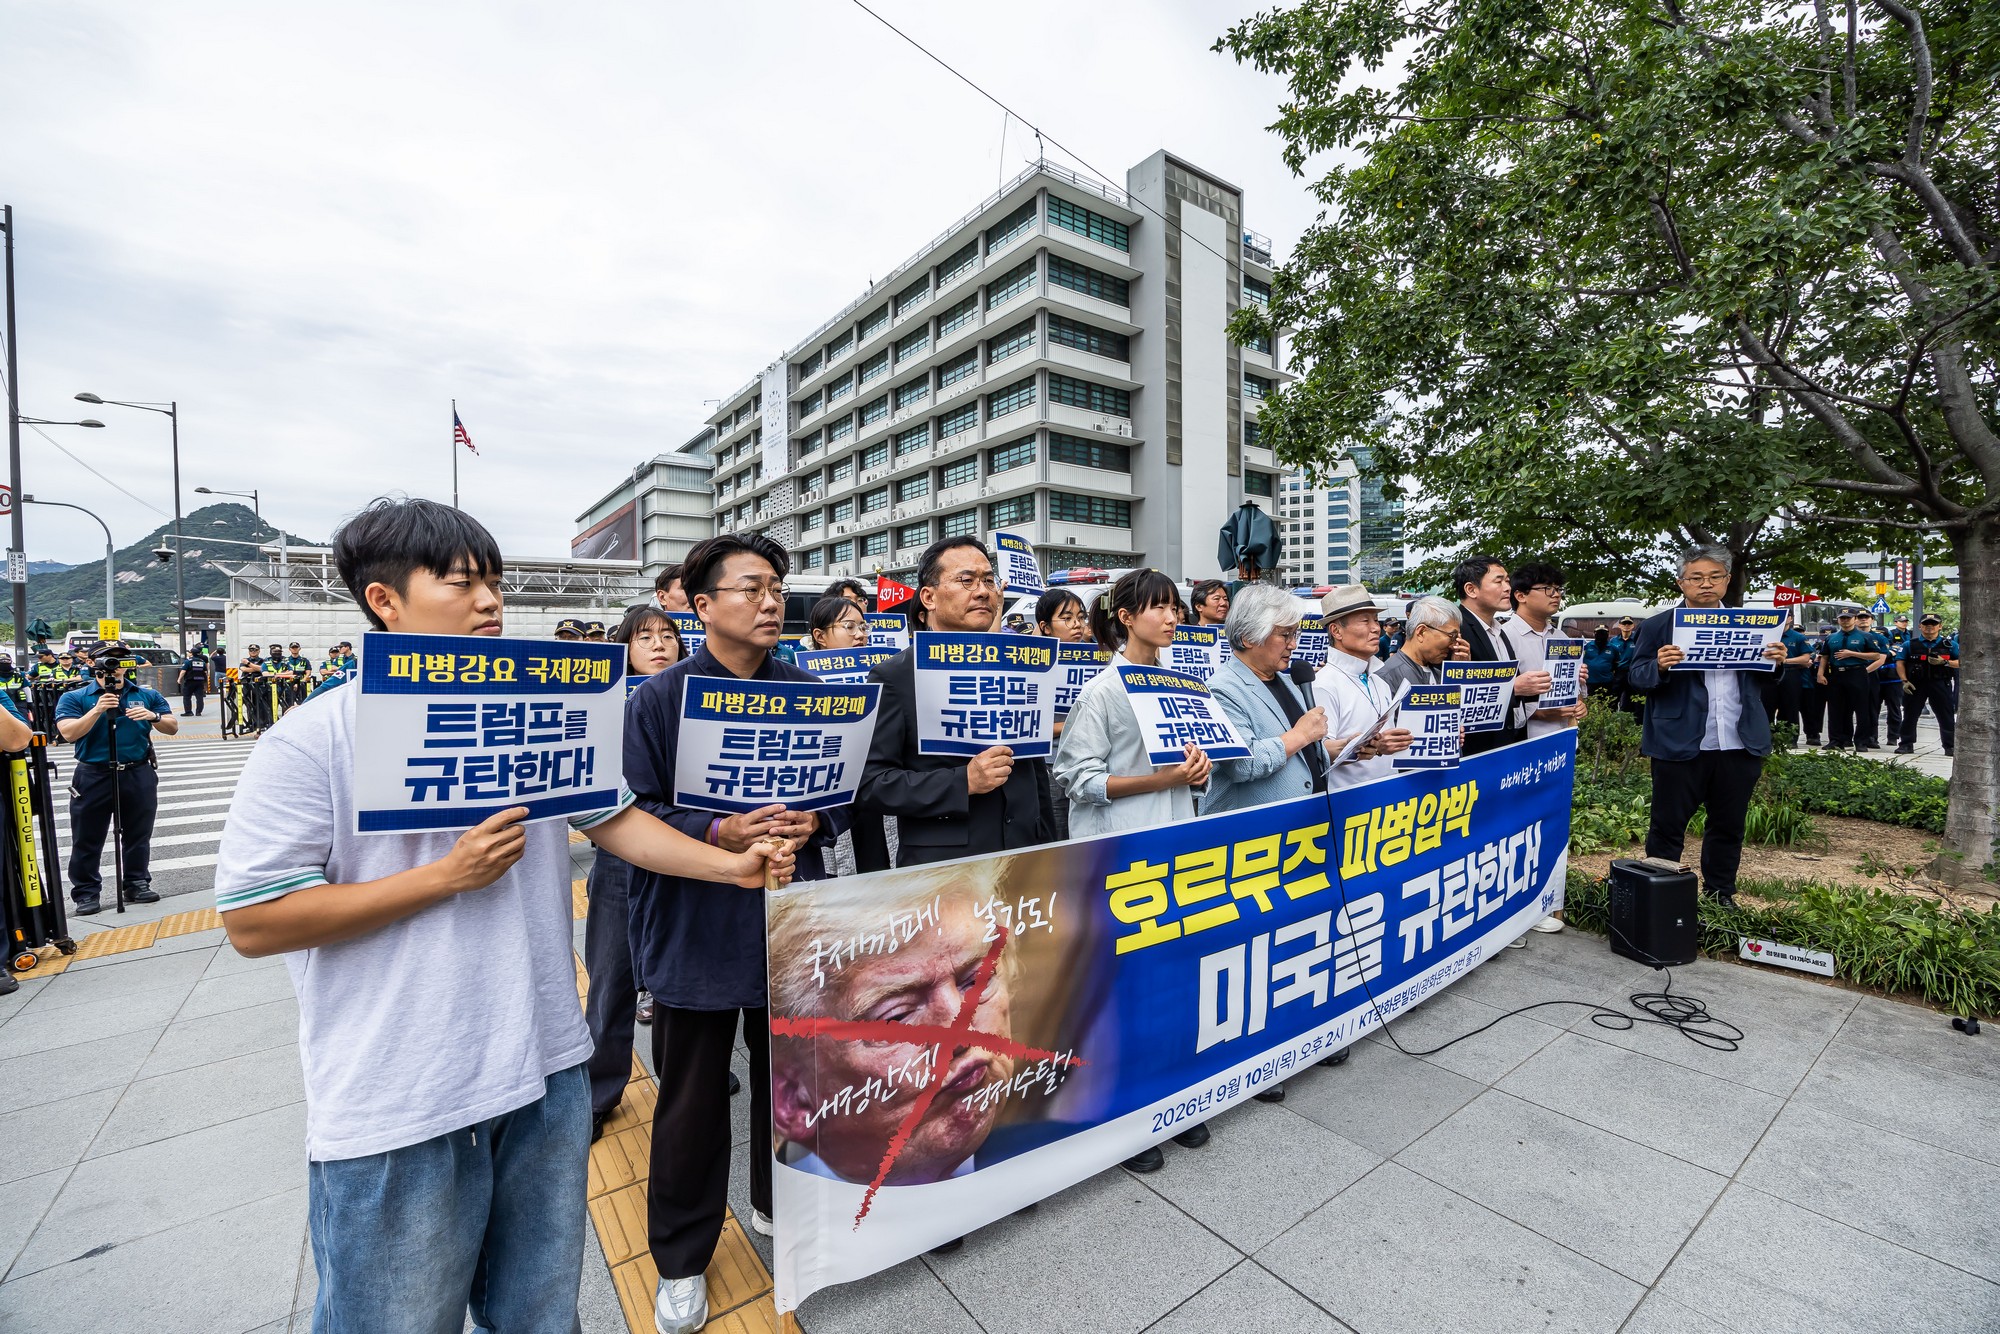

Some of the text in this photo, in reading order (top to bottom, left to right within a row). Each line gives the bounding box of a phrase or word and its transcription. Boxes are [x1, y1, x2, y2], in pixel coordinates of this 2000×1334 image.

[879, 588, 904, 602] 43기-3
[1776, 592, 1805, 602] 43기-1
[1683, 614, 1779, 625] 파병강요 국제깡패
[1695, 630, 1763, 646] 트럼프를
[807, 656, 857, 671] 파병강요
[928, 643, 1051, 666] 파병강요 국제깡패
[1687, 647, 1765, 662] 규탄한다!
[388, 652, 611, 685] 파병강요 국제깡패
[1125, 673, 1147, 686] 이란
[1147, 674, 1182, 688] 침략전쟁
[1446, 669, 1464, 679] 이란
[1466, 668, 1493, 679] 침략전쟁
[1553, 662, 1575, 679] 미국을
[948, 676, 1038, 705] 트럼프를
[1409, 693, 1446, 706] 호르무즈
[1464, 685, 1501, 705] 미국을
[701, 691, 867, 717] 파병강요 국제깡패
[1157, 696, 1213, 720] 미국을
[424, 702, 587, 748] 트럼프를
[941, 709, 1041, 740] 규탄한다!
[1156, 721, 1235, 748] 규탄한다!
[1424, 713, 1458, 734] 미국을
[719, 728, 842, 761] 트럼프를
[404, 746, 595, 802] 규탄한다!
[705, 762, 845, 798] 규탄한다!
[18, 786, 38, 891] POLICE LINE
[1105, 780, 1479, 956] 호르무즈 파병압박
[805, 892, 1056, 988] 국제깡패! 날강도!
[1195, 820, 1543, 1055] 미국을 규탄한다!
[1152, 1089, 1212, 1133] 2026년
[1216, 1075, 1241, 1103] 9월
[1245, 1050, 1296, 1088] 10일(목)
[1299, 1036, 1323, 1062] 오후
[1325, 1023, 1344, 1048] 2시
[1452, 955, 1466, 976] 2번
[1465, 945, 1482, 968] 출구)
[805, 1043, 1073, 1128] 내정간섭! 경제수탈!
